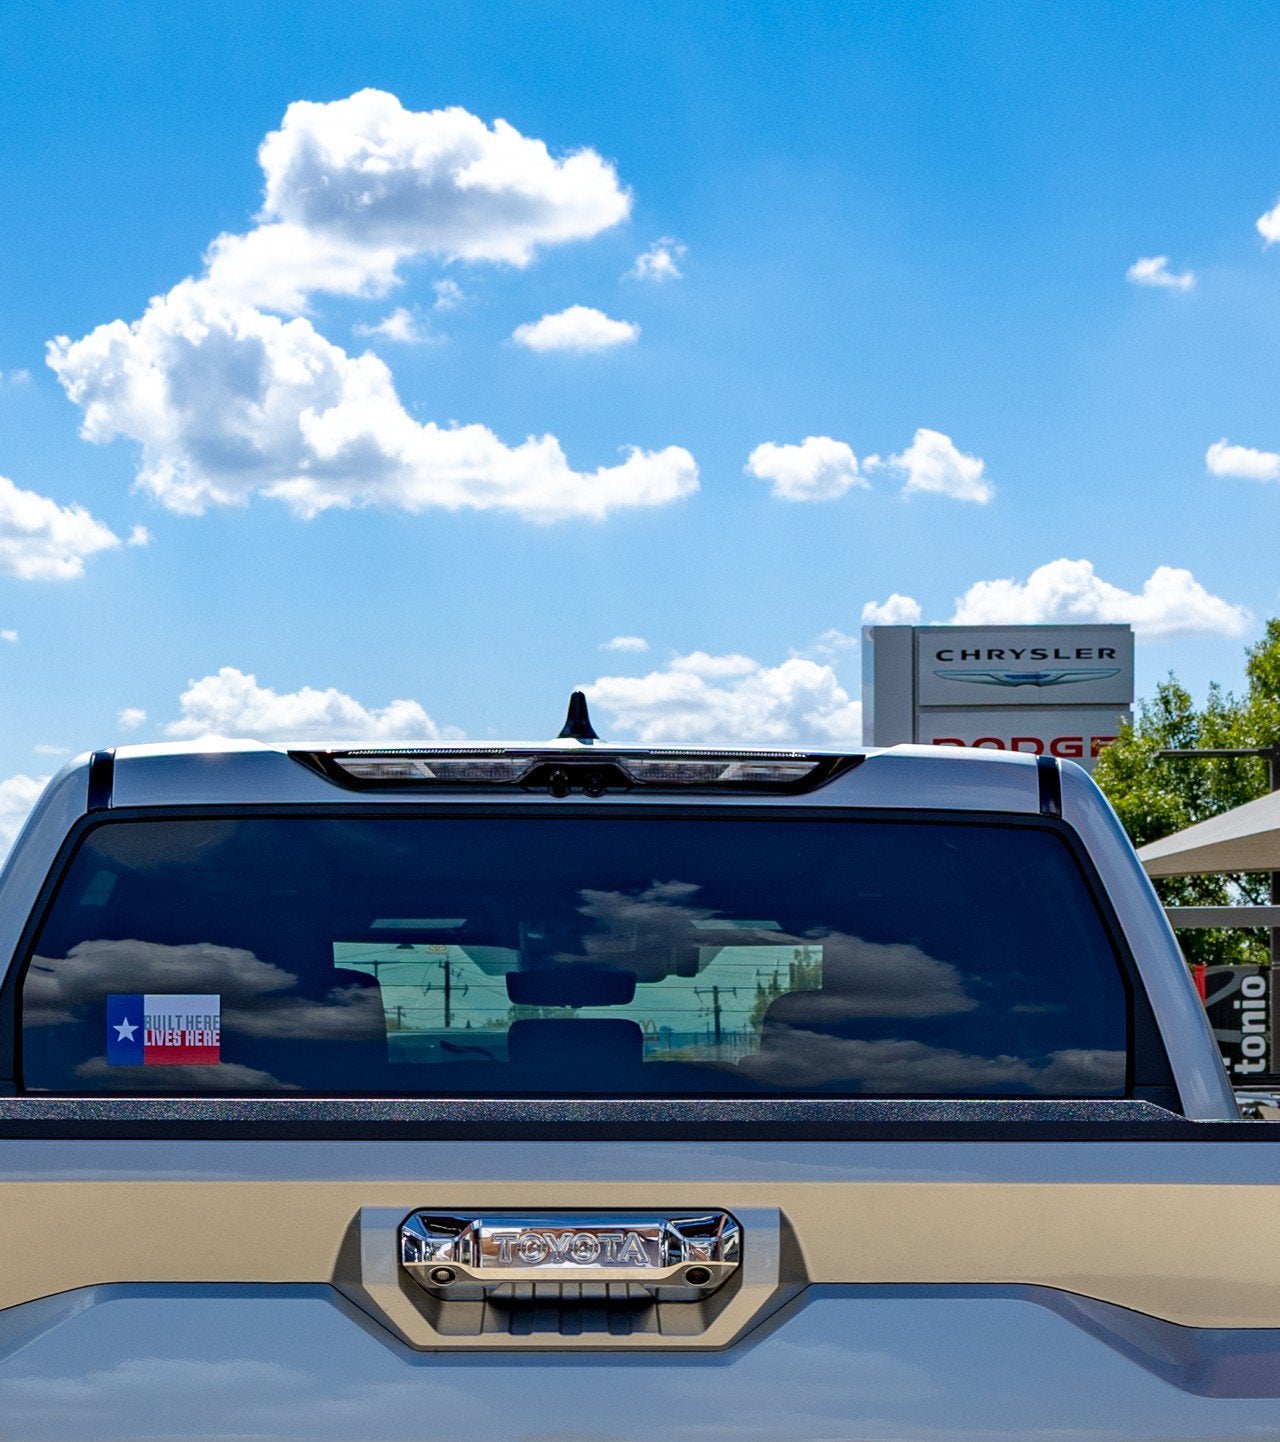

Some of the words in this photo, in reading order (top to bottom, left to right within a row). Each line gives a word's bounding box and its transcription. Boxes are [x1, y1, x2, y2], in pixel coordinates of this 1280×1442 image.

[935, 648, 1116, 662] CHRYSLER
[144, 1015, 183, 1031] BUILT
[185, 1015, 220, 1031] HERE
[144, 1030, 182, 1046] LIVES
[185, 1030, 220, 1046] HERE
[492, 1231, 650, 1265] TOYOTA
